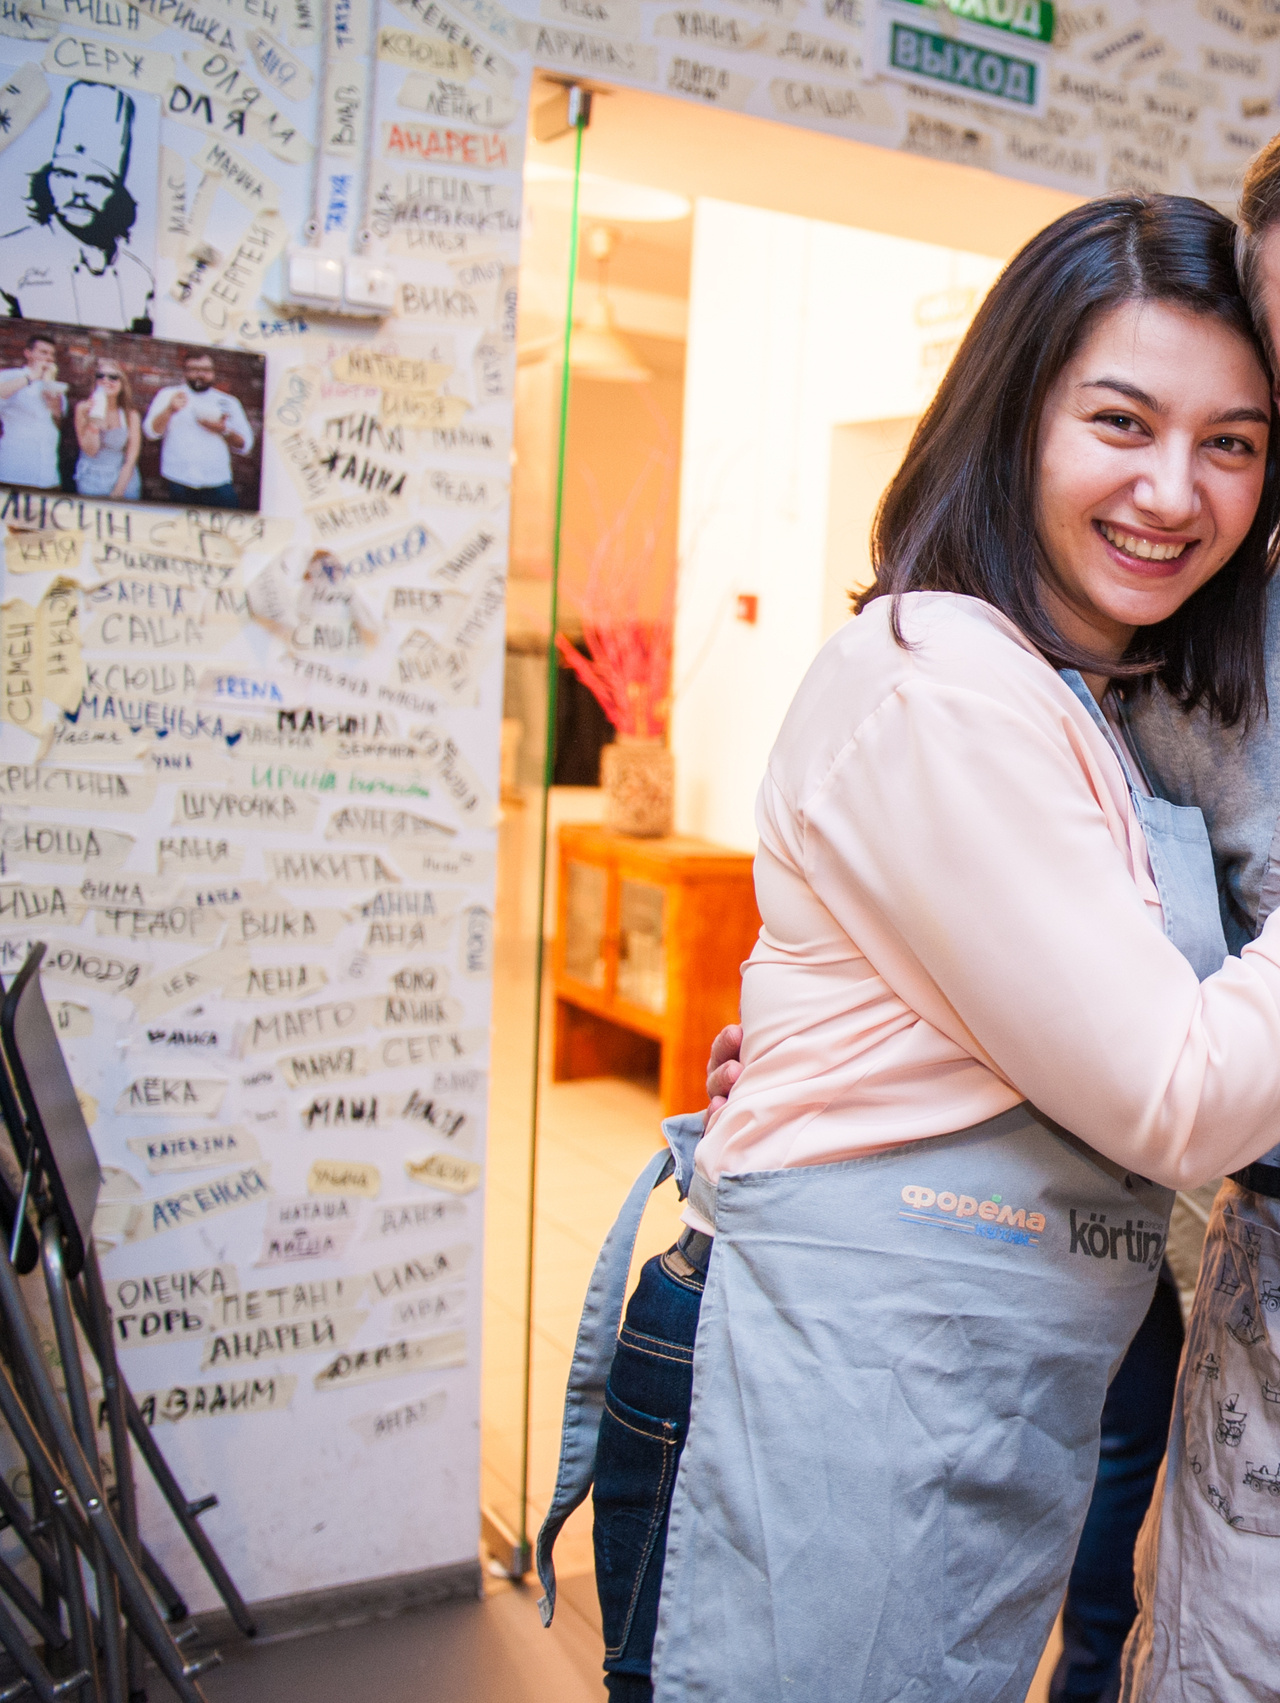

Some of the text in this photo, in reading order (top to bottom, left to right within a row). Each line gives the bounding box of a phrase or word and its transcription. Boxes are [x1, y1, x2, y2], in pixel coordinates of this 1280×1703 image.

[893, 27, 1031, 102] ВЫХОД
[169, 84, 247, 137] ОЛЯ
[387, 124, 509, 167] АНДРЕЙ
[101, 612, 204, 649] САША
[86, 663, 197, 695] КСЮША
[80, 688, 224, 740] МАШЕНЬКА
[241, 910, 318, 941] ВИКА
[47, 950, 141, 993] ОЛОДЯ
[246, 964, 308, 996] ЛЕНА
[252, 1002, 359, 1047] МАРГО
[117, 1266, 226, 1311] ОЛЕЧКА
[116, 1307, 203, 1341] ГОРЬ
[209, 1320, 337, 1368] АНДРЕЙ
